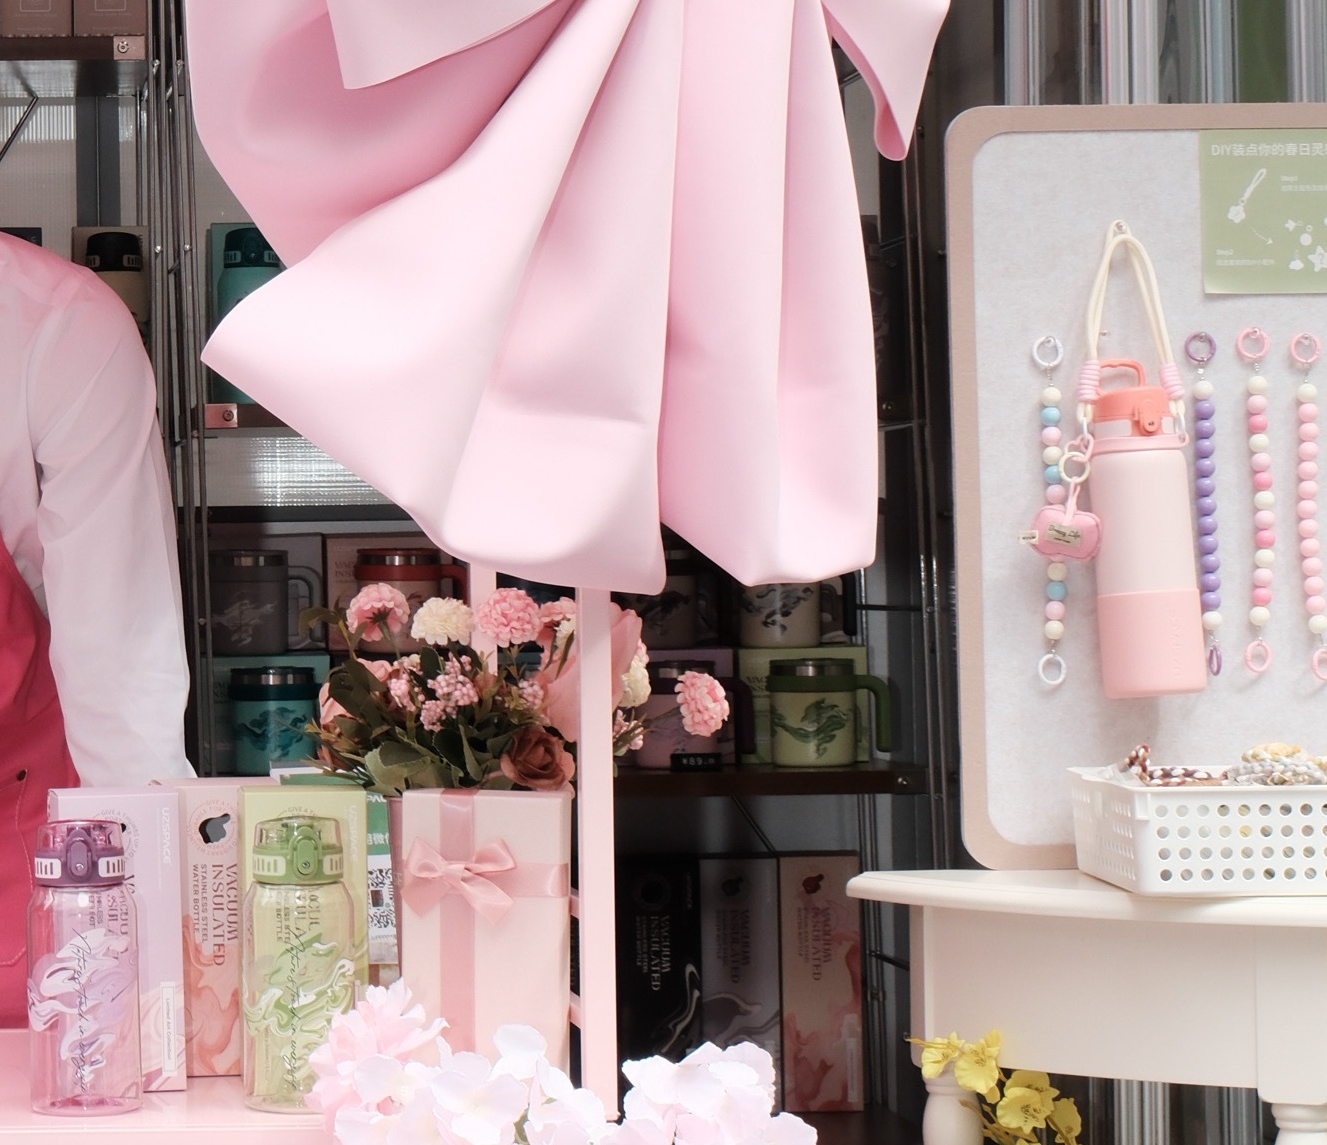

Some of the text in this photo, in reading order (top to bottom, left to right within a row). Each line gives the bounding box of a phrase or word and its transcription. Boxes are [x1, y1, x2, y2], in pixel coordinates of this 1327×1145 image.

[161, 807, 172, 864] UZSPACE
[212, 864, 226, 967] INSULATED
[226, 863, 239, 941] VACUUM
[650, 916, 662, 991] INSULATED
[661, 915, 671, 973] VACUUM
